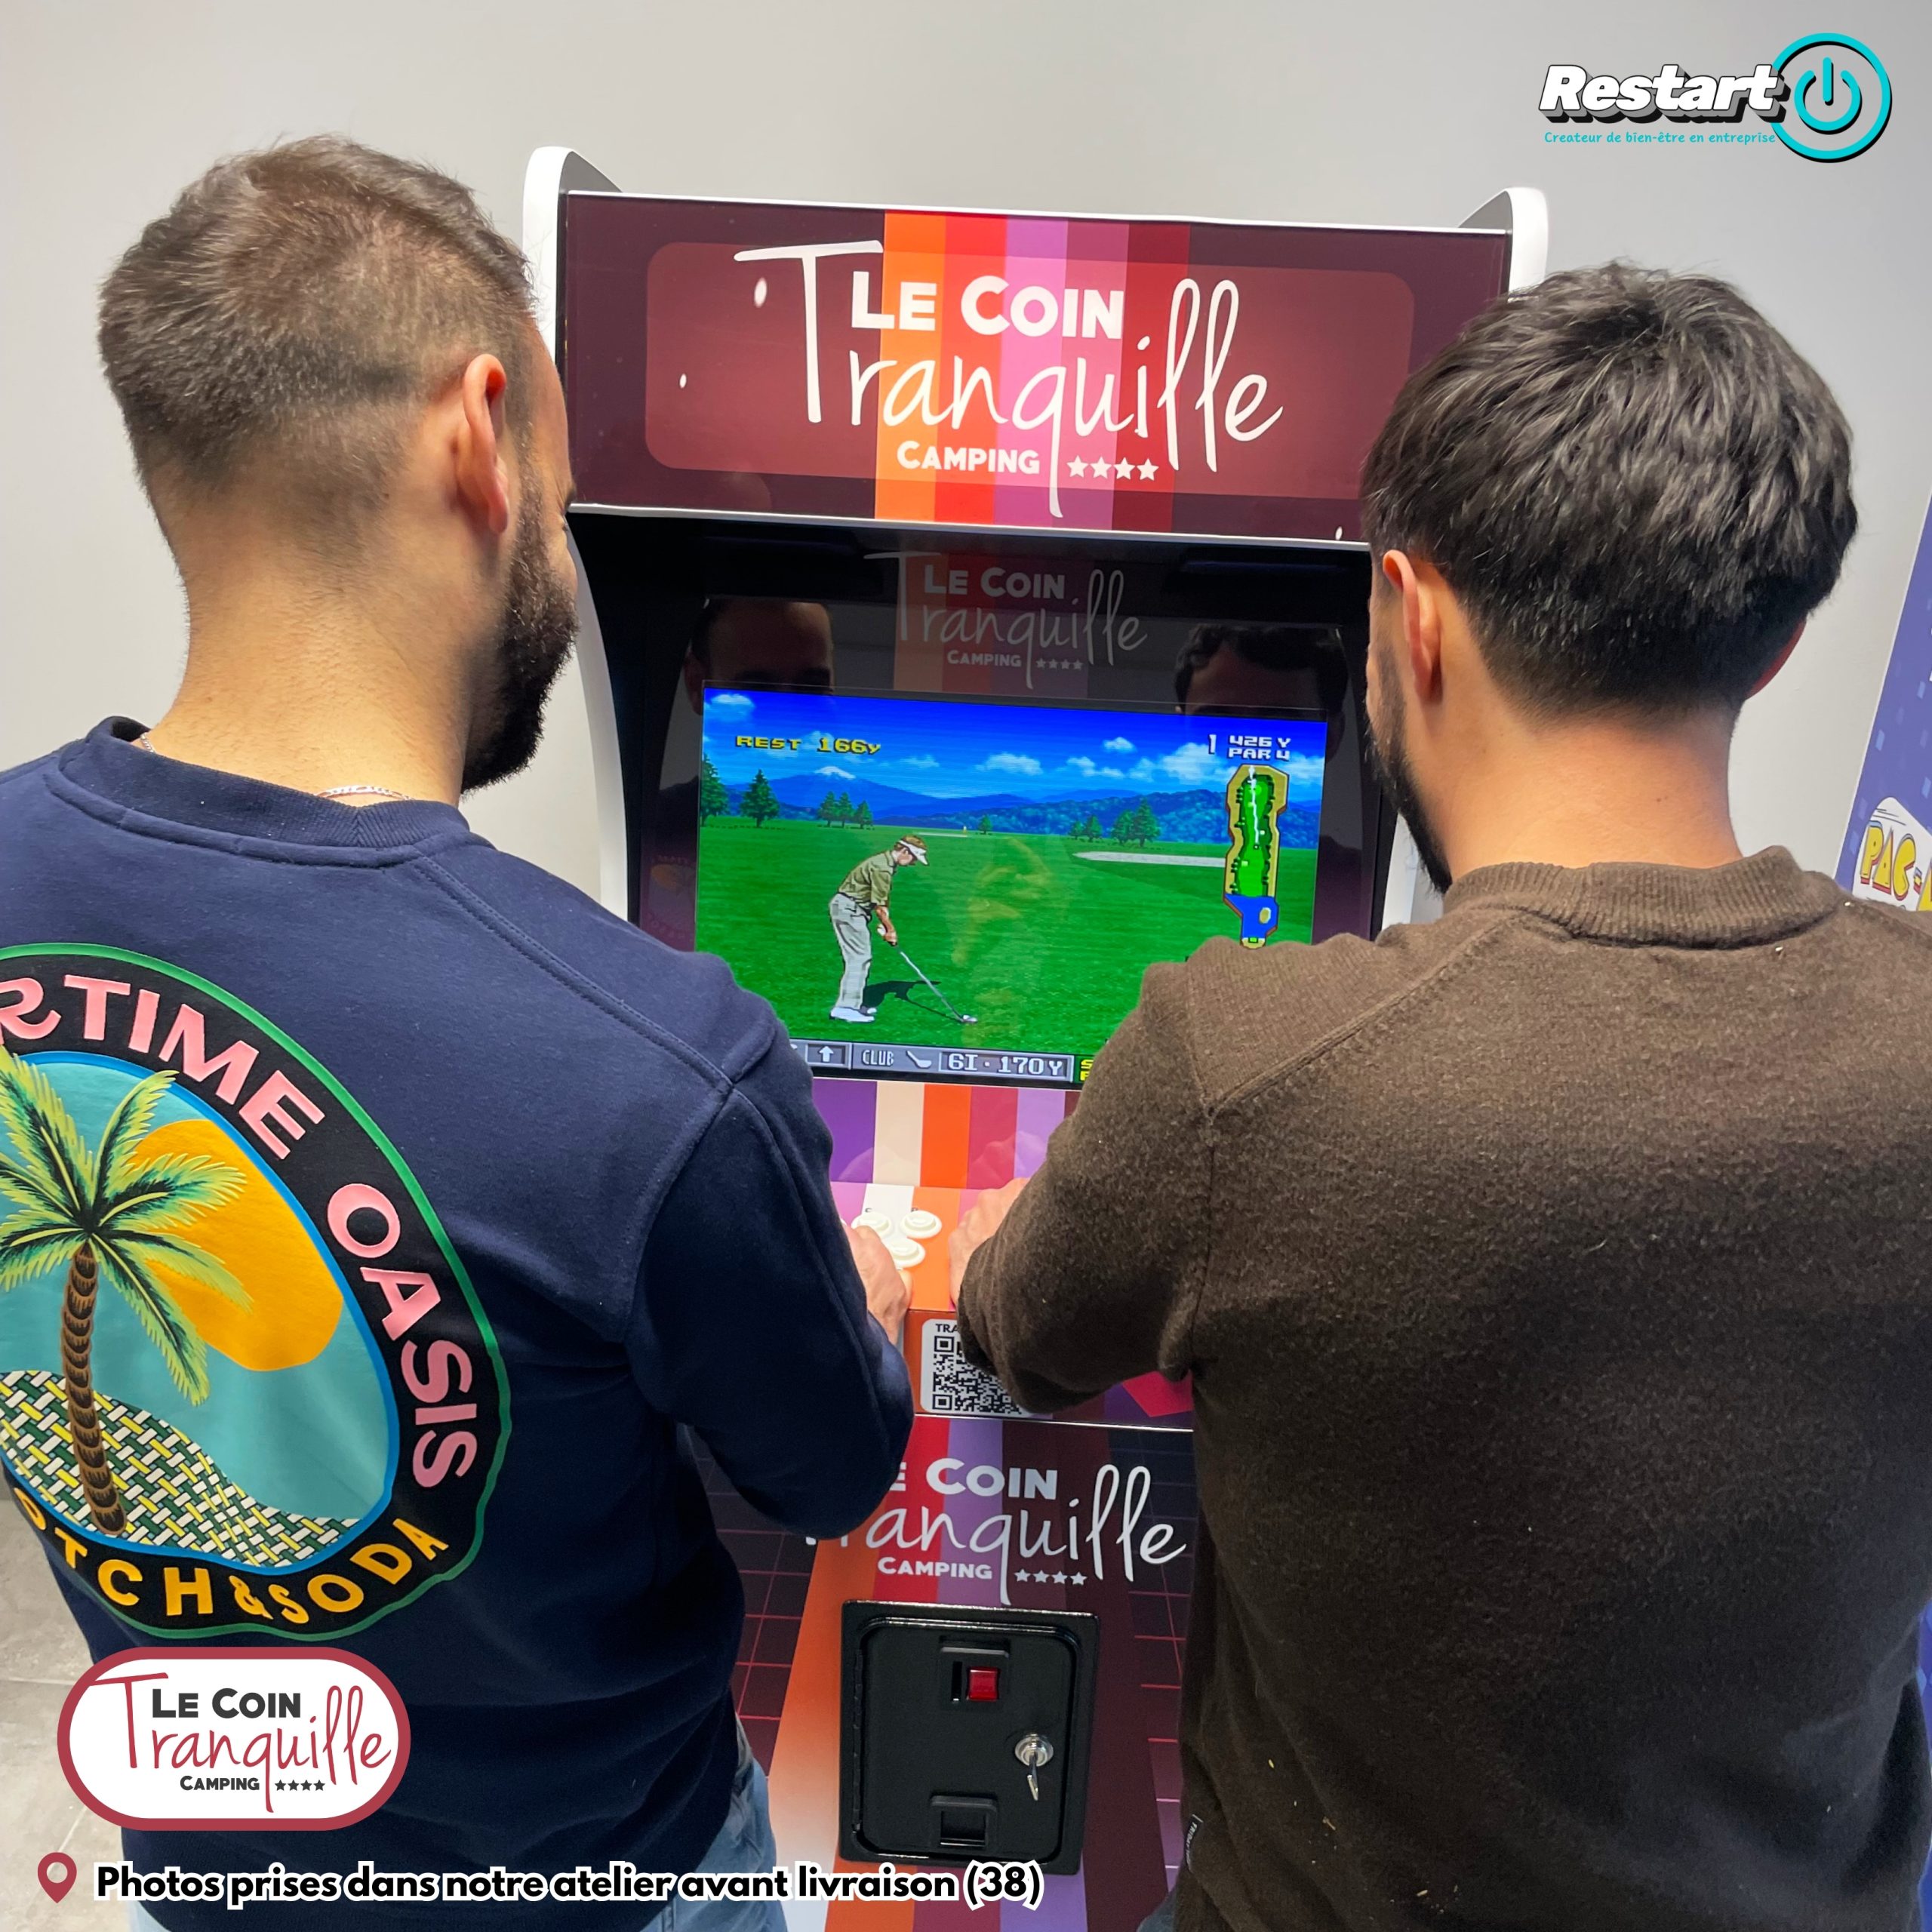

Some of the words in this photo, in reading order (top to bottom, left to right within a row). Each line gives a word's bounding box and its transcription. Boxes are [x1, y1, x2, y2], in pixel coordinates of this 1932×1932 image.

[734, 240, 1283, 518] Tranquille
[863, 550, 1147, 690] Tranquille
[736, 736, 801, 751] REST
[1227, 747, 1272, 760] PAR
[1228, 734, 1272, 747] 426
[1277, 737, 1291, 749] Y
[862, 1049, 894, 1066] CLUB
[327, 1183, 477, 1487] OASIS
[806, 1464, 1186, 1605] anquille
